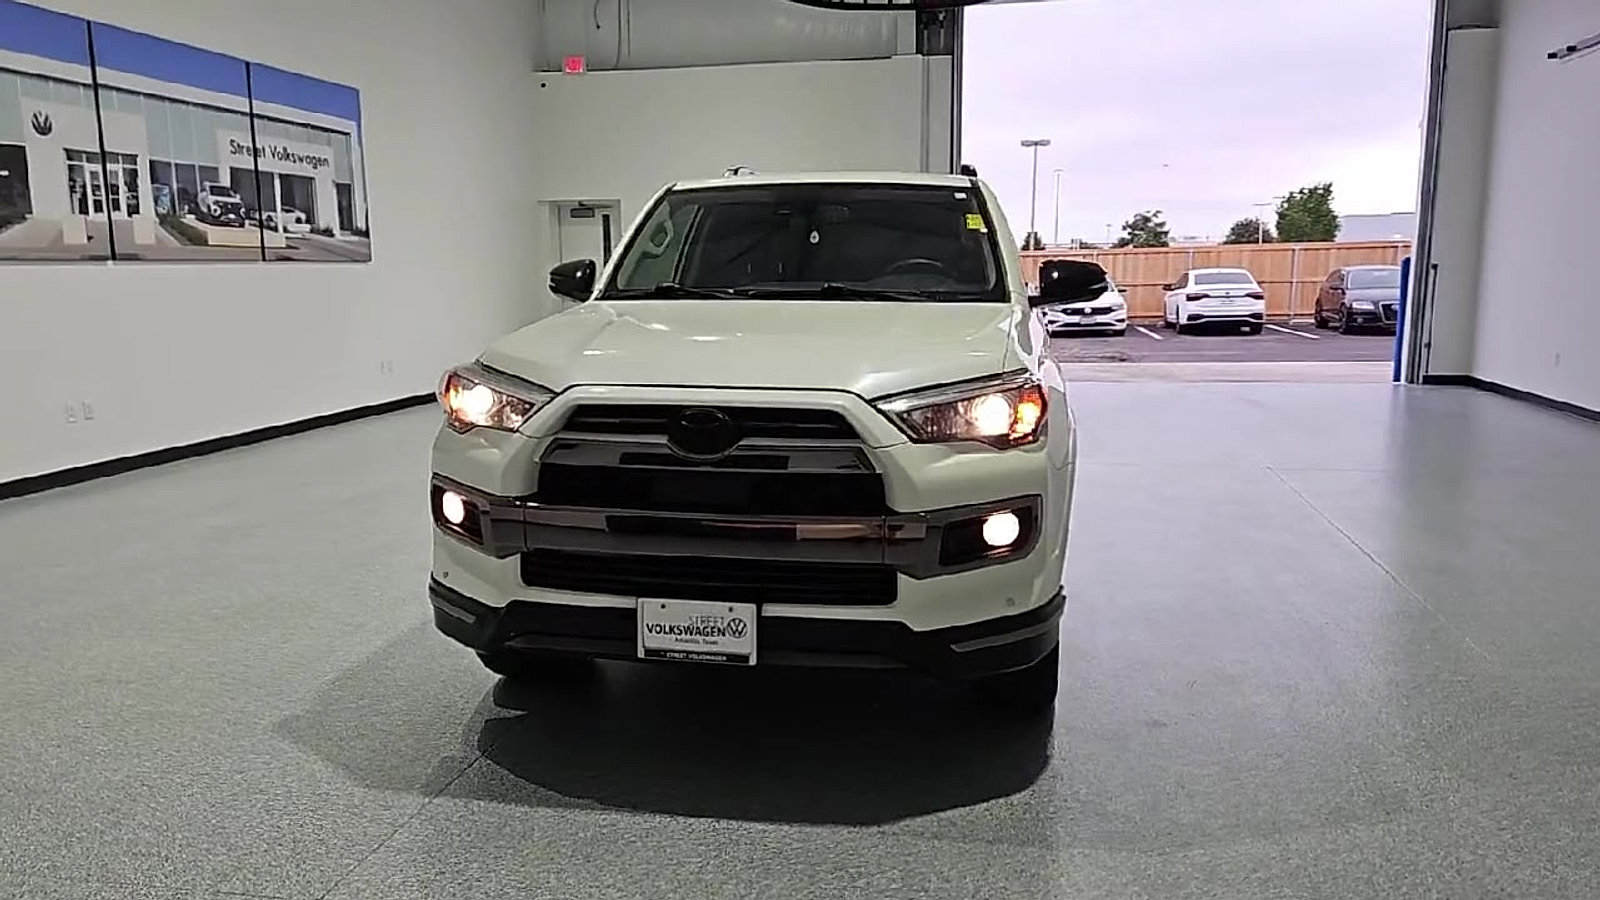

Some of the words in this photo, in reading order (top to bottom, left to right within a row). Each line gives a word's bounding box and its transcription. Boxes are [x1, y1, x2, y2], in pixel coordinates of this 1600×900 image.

[229, 139, 266, 159] Street
[268, 144, 330, 170] Volkswagen
[689, 615, 725, 627] STREET
[646, 623, 726, 638] VOLKSWAGEN
